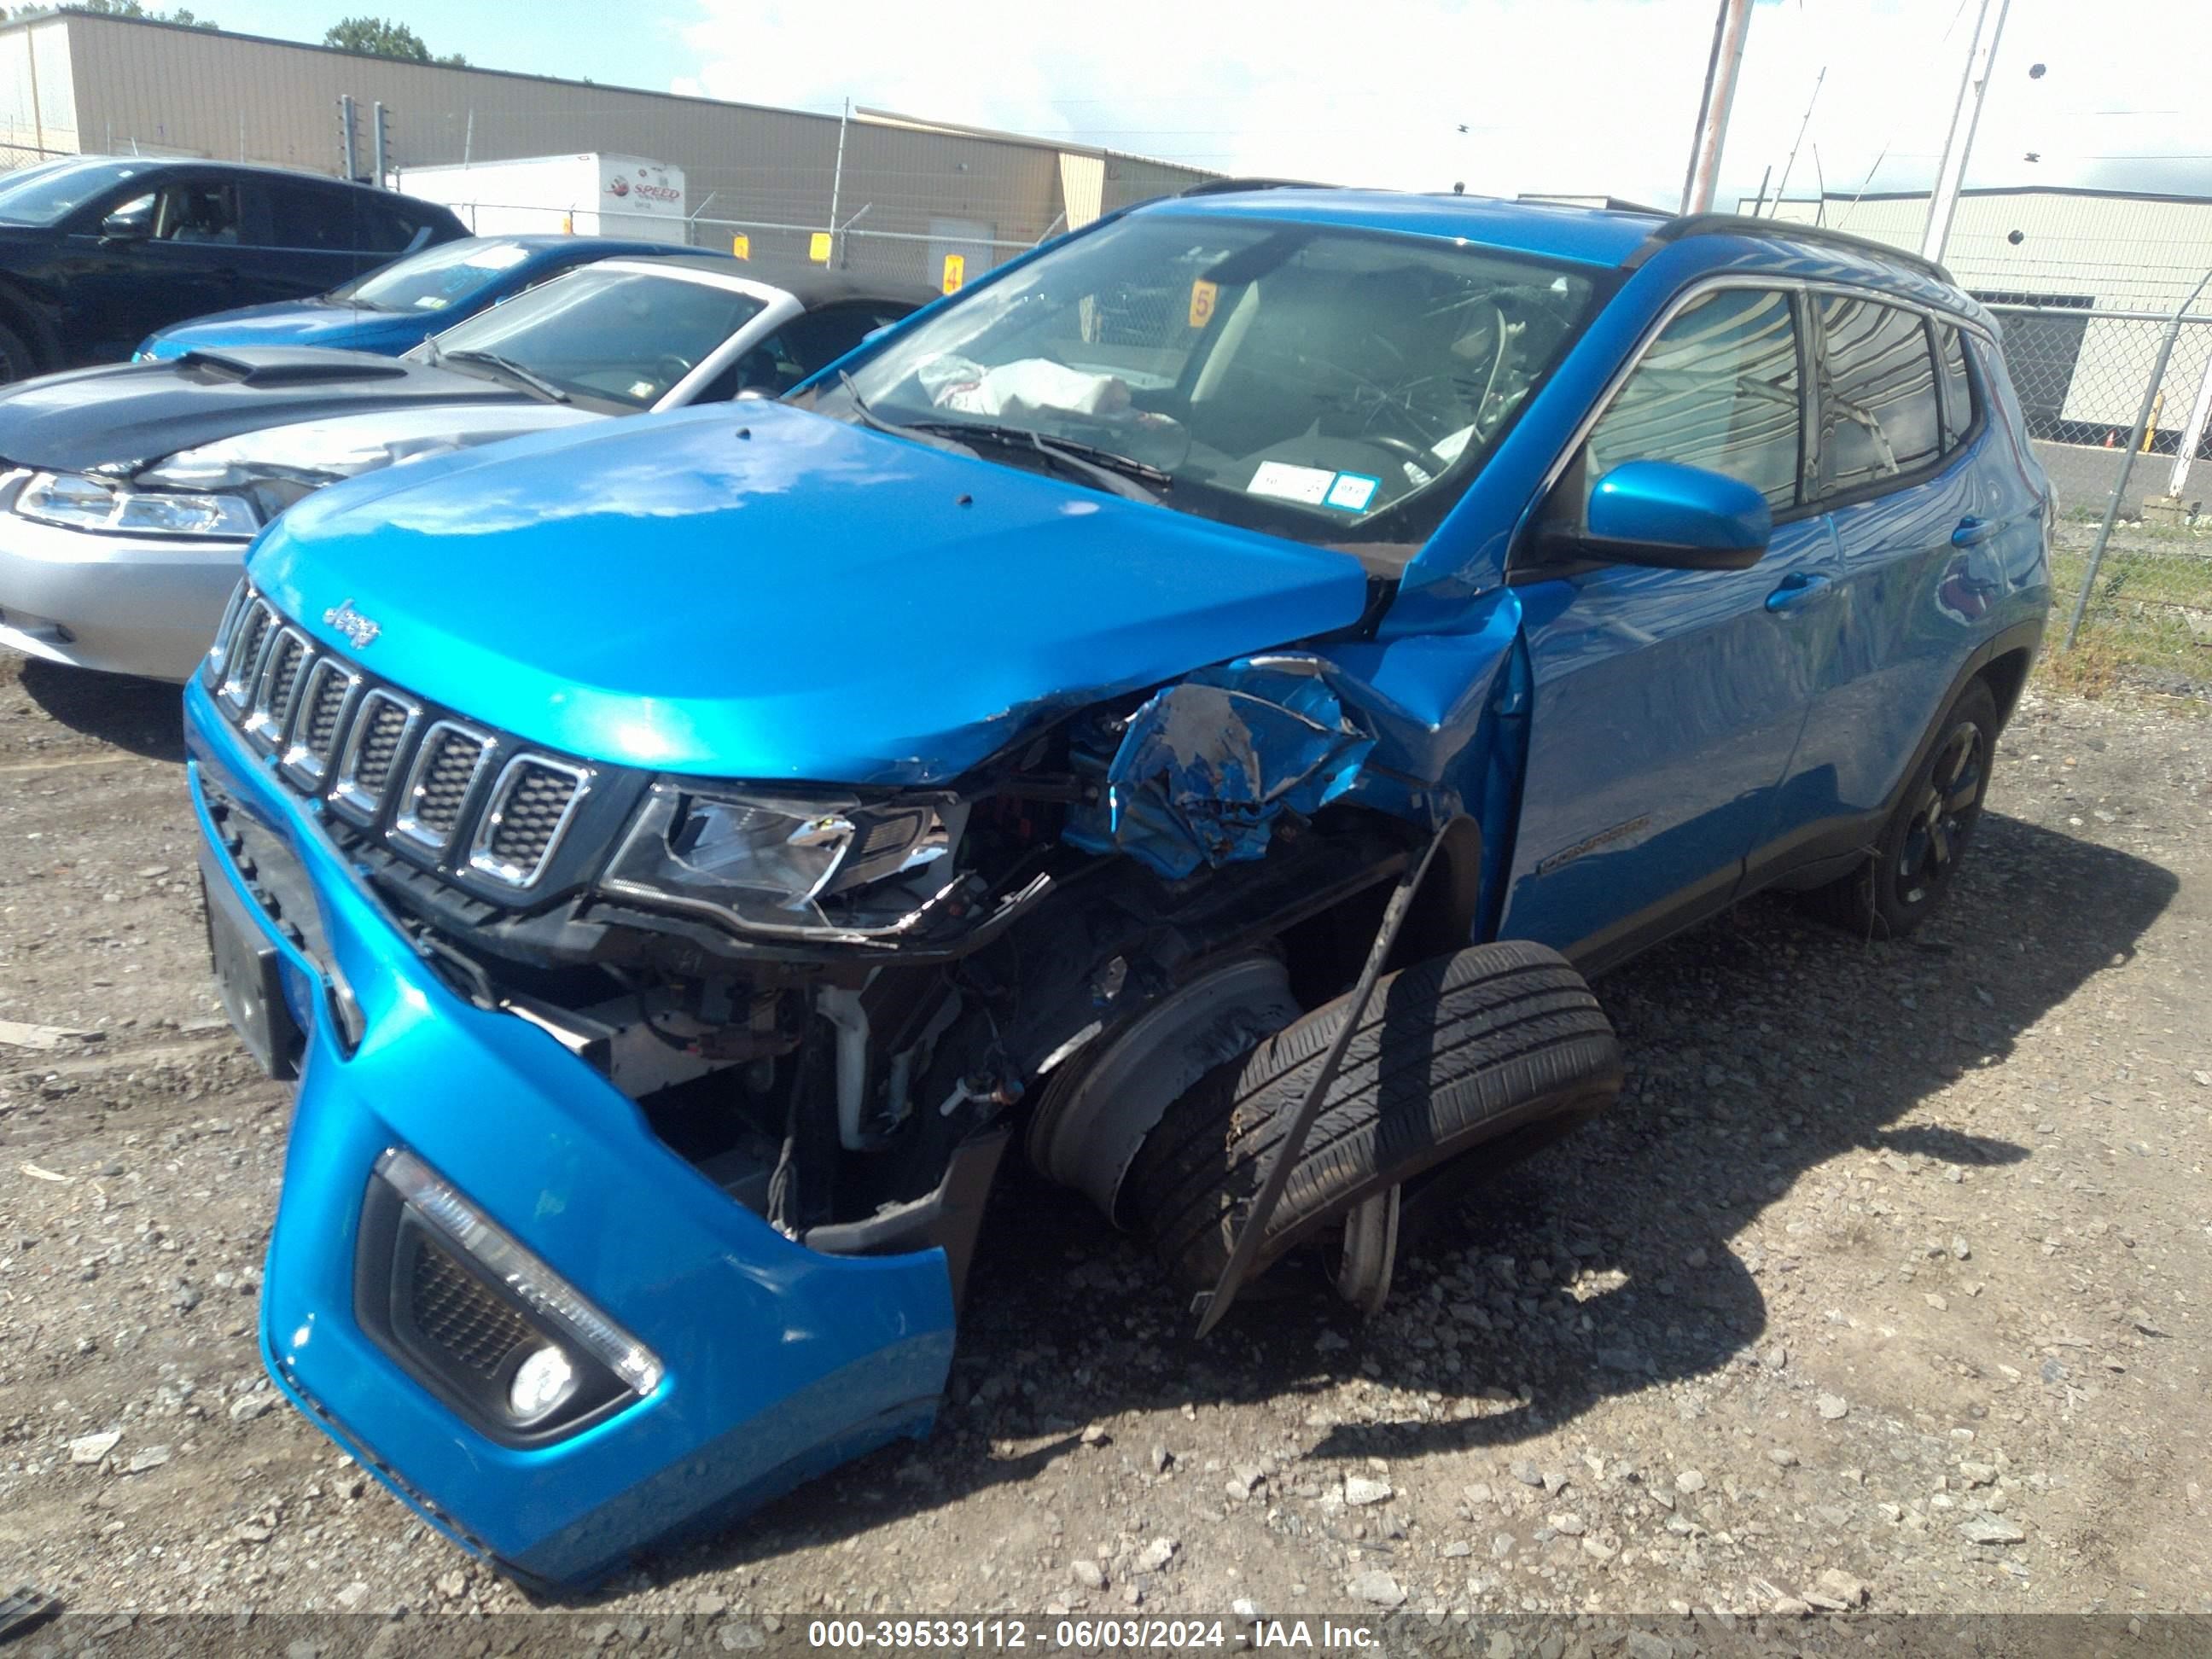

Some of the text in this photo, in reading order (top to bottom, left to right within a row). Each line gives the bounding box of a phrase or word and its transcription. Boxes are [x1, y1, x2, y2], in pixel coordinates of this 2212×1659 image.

[634, 183, 680, 199] SPEED
[947, 265, 958, 289] 4
[1196, 289, 1209, 317] 5
[323, 598, 382, 649] Jeep
